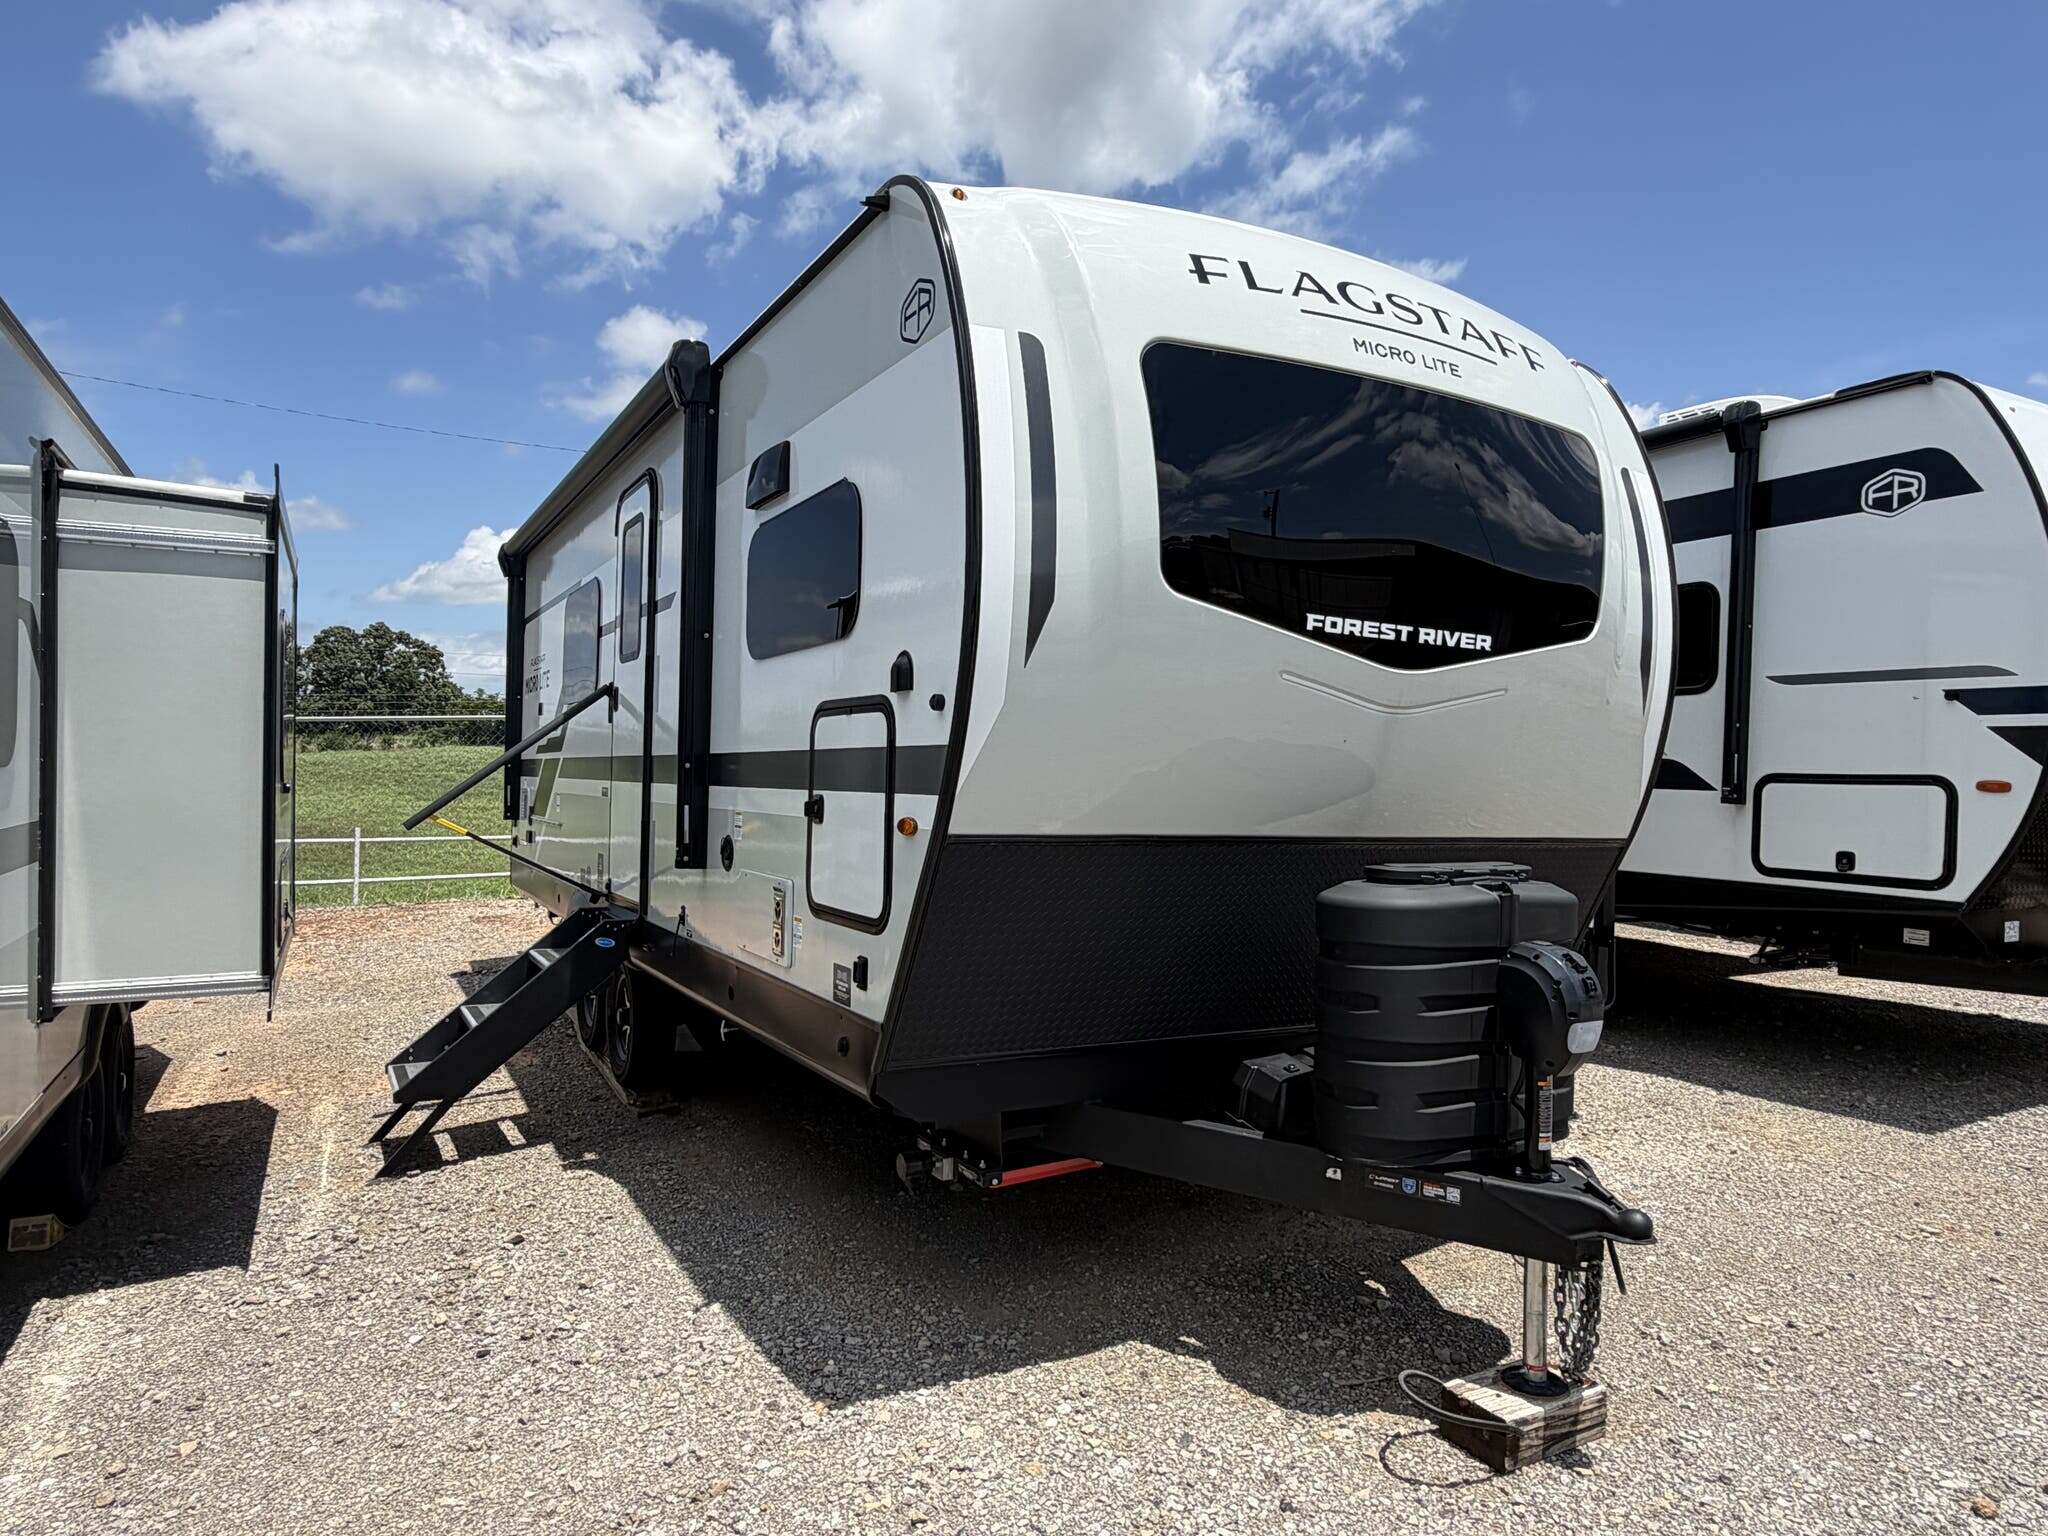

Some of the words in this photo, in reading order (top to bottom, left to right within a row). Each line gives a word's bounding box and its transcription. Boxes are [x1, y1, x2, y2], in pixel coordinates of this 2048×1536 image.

[1188, 253, 1545, 373] FLAGSTAFF
[1352, 337, 1416, 366] MICRO
[1422, 355, 1463, 379] LITE
[1867, 474, 1920, 510] FR
[1305, 612, 1414, 642] FOREST
[1418, 626, 1493, 652] RIVER
